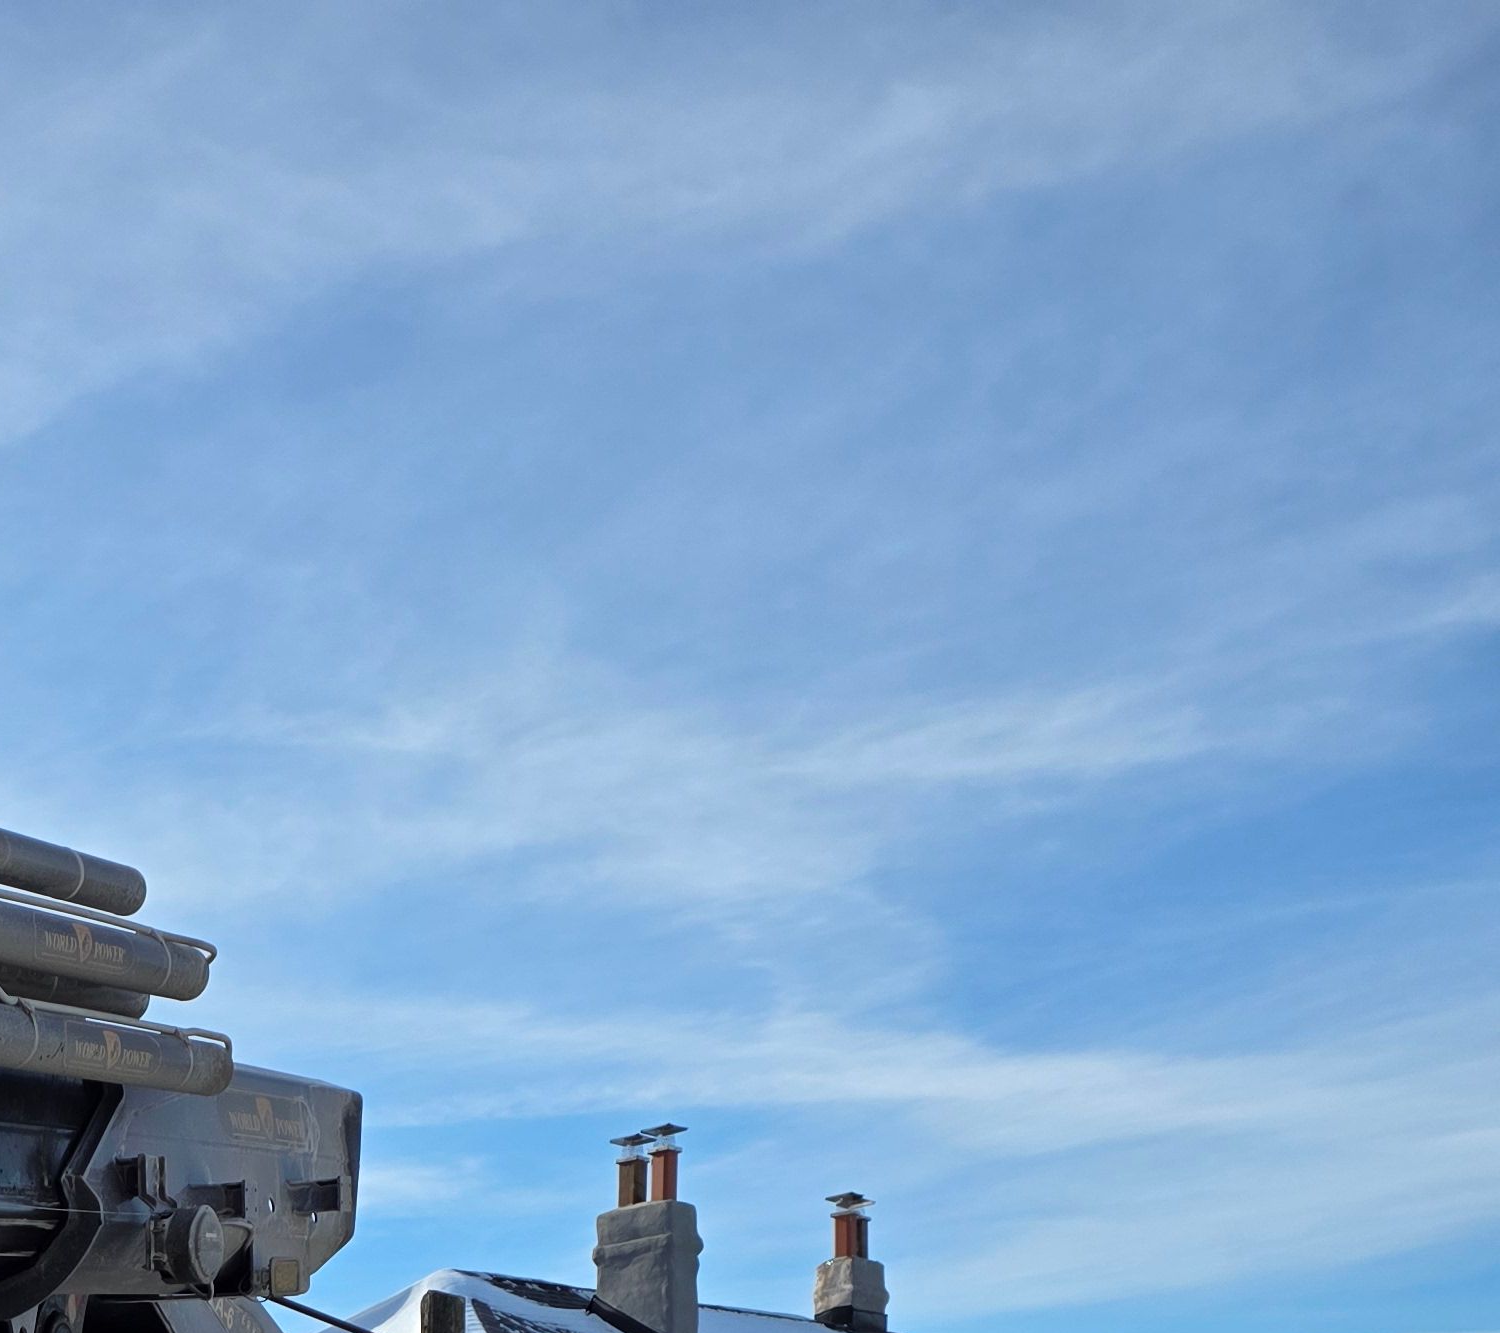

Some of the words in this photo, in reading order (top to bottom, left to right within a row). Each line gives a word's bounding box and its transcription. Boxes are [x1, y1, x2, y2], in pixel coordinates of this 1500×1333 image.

[44, 930, 78, 953] WORLD
[94, 941, 126, 964] POWER
[75, 1039, 106, 1061] WORLD
[121, 1048, 151, 1069] POWER
[228, 1111, 261, 1132] WORLD
